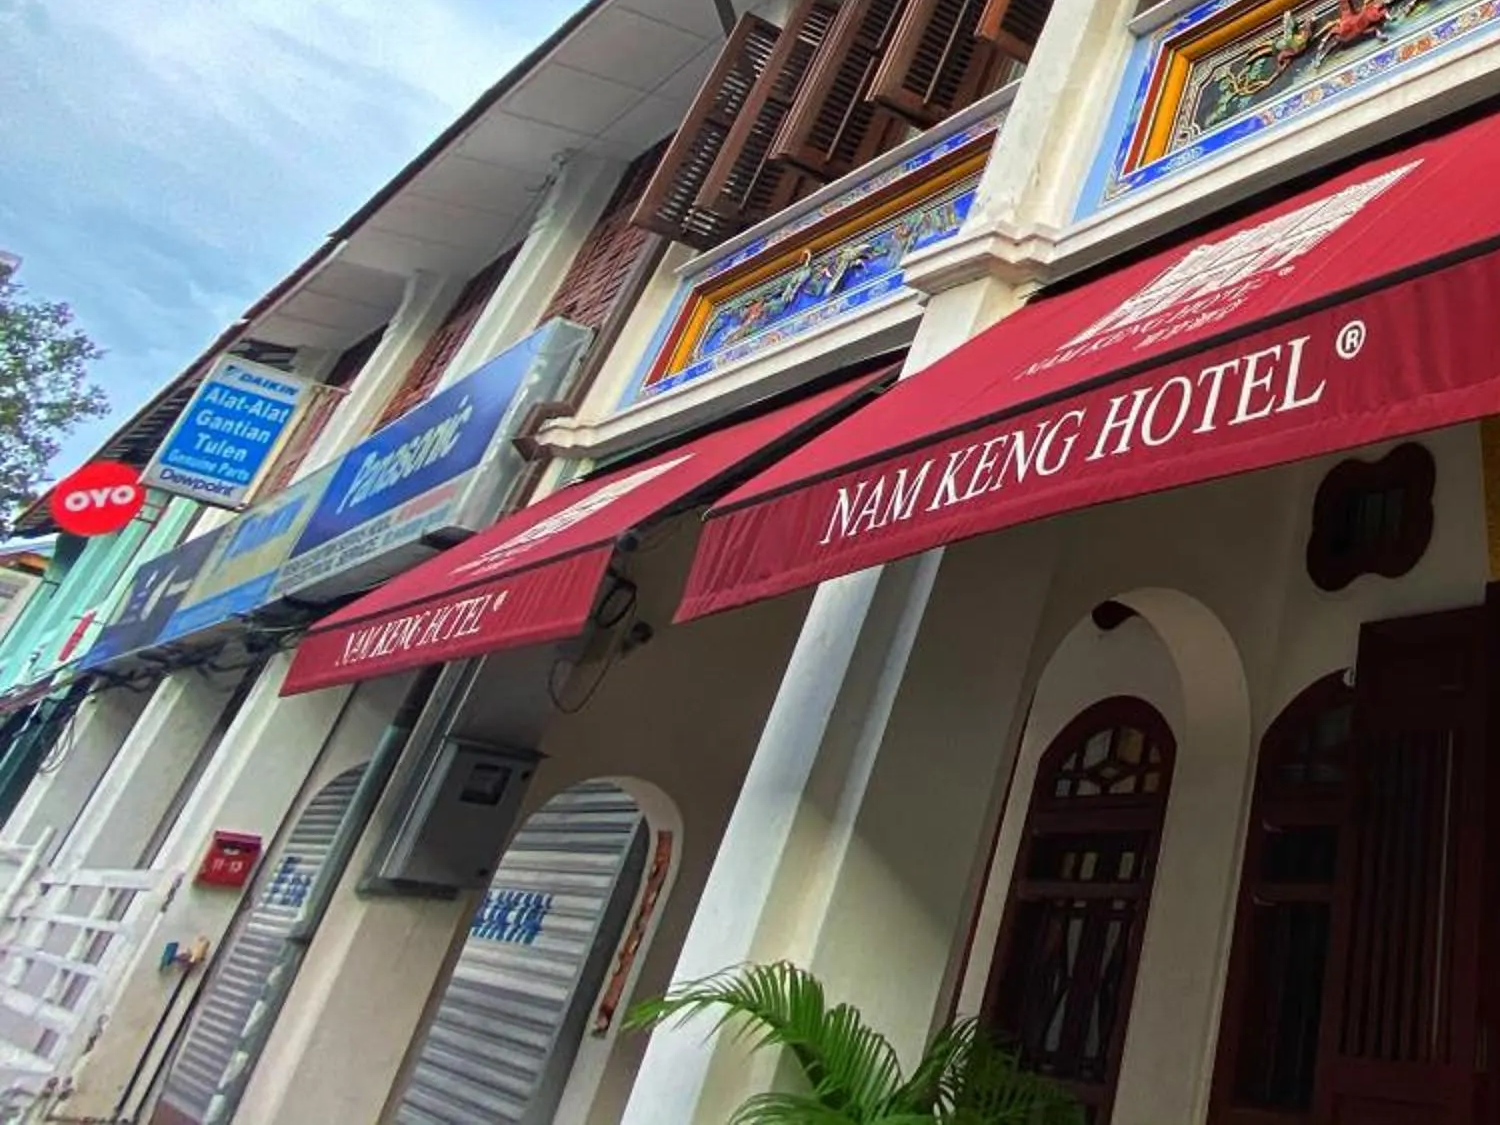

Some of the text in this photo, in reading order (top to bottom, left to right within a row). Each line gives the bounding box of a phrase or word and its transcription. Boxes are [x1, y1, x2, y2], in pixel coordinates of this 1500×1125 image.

[239, 372, 299, 395] DAIKIN
[204, 387, 289, 424] Alat-Alat
[195, 409, 271, 444] Gantian
[819, 457, 937, 545] NAM
[926, 409, 1085, 513] KENG
[1087, 337, 1328, 461] HOTEL
[194, 432, 249, 462] Tulen
[217, 462, 250, 481] Parts
[65, 484, 136, 512] OYO
